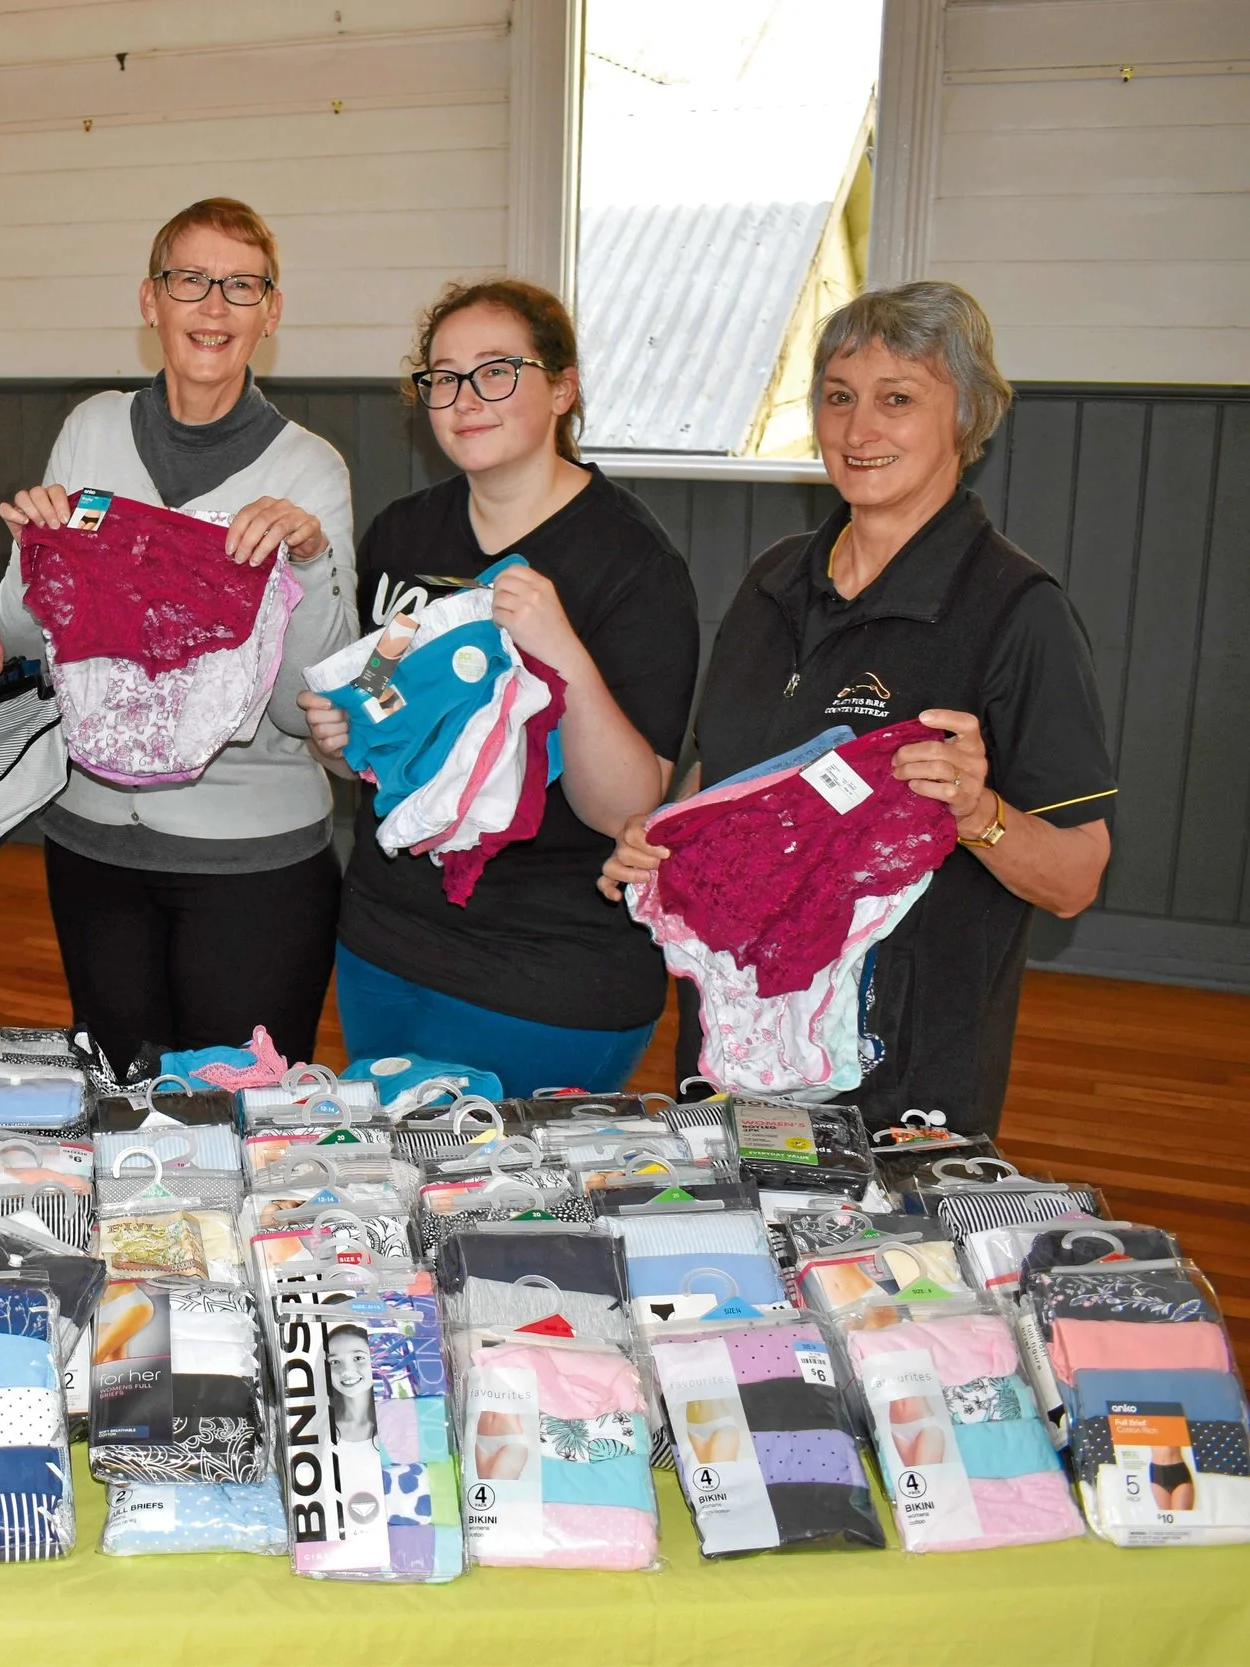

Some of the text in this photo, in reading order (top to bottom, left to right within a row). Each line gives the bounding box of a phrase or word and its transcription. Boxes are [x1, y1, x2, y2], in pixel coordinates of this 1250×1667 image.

[865, 699, 886, 708] PARK
[854, 706, 890, 718] RETREAT
[741, 1120, 806, 1128] WOMEN'S
[100, 1368, 162, 1388] for her
[811, 1368, 827, 1382] $6
[100, 1381, 153, 1395] WOMENS FULL
[100, 1389, 125, 1399] BRIEFS
[470, 1388, 532, 1400] favourites
[1111, 1404, 1137, 1413] anko
[1114, 1418, 1129, 1426] Full
[279, 1321, 327, 1543] BONDS
[1116, 1426, 1141, 1434] Cotton
[700, 1470, 713, 1485] 4
[906, 1473, 919, 1490] 4
[1126, 1474, 1140, 1495] 5
[116, 1490, 126, 1502] 2
[474, 1486, 488, 1504] 4
[698, 1493, 728, 1504] BIKINI
[112, 1502, 164, 1518] ULL BRIEFS
[905, 1501, 935, 1513] BIKINI
[468, 1515, 498, 1525] BIKINI
[1157, 1513, 1174, 1524] $10
